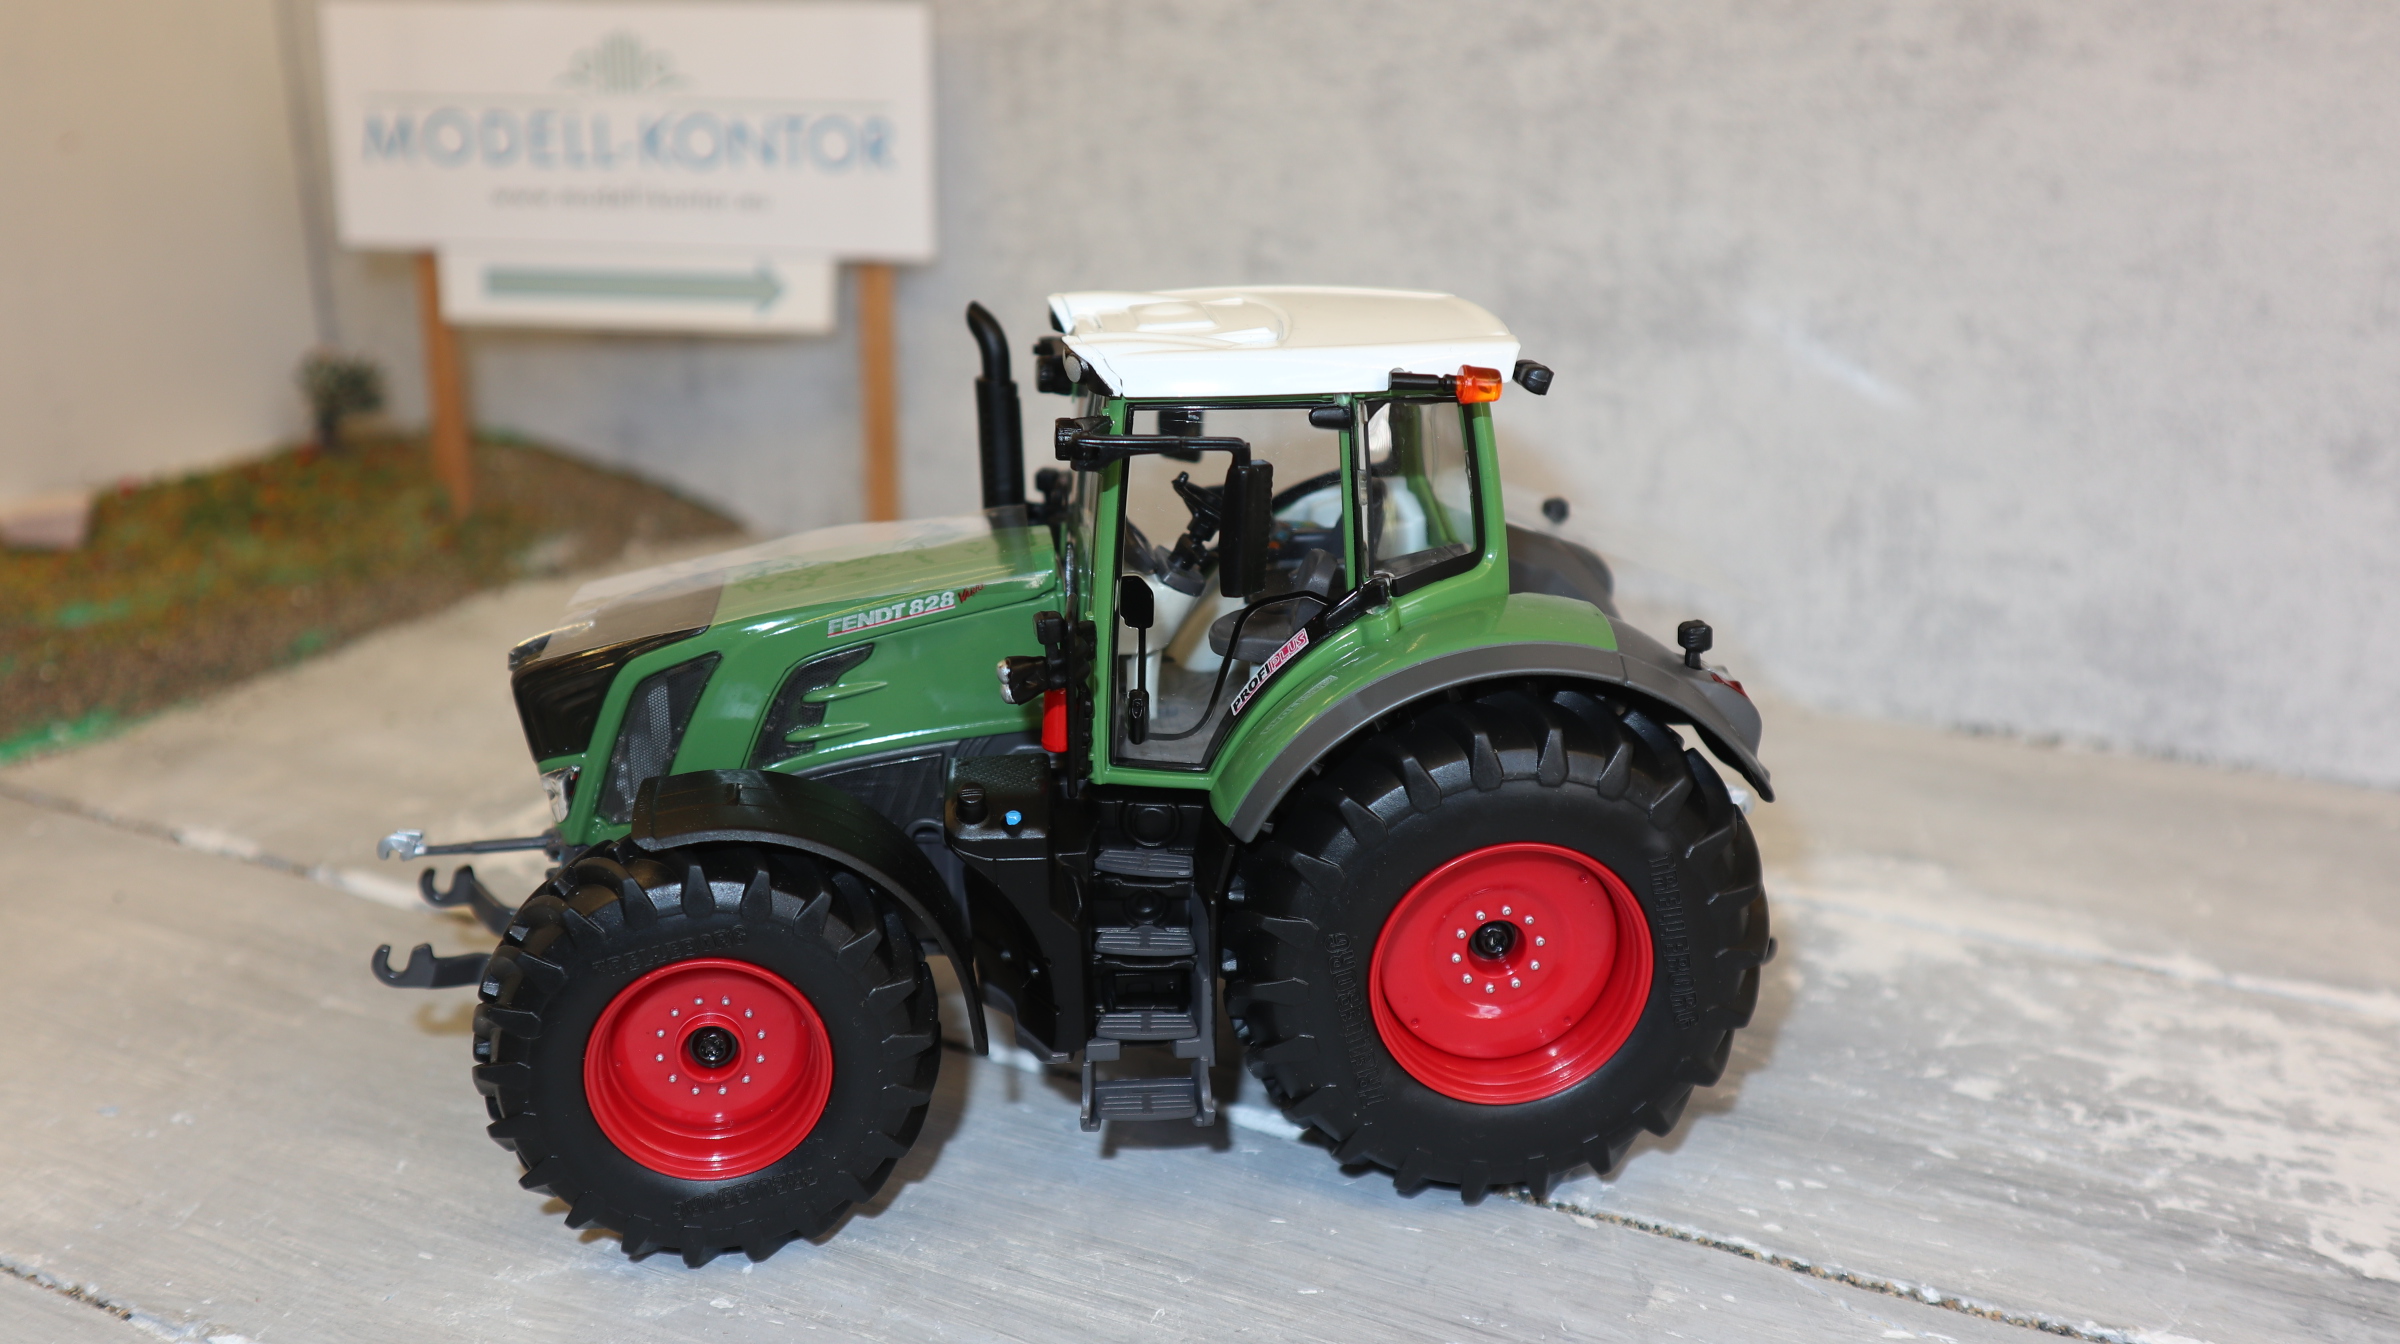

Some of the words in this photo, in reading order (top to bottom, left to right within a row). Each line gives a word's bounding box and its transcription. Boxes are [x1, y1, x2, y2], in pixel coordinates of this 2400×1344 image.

[362, 107, 900, 176] MODELL-KONTOR
[827, 602, 907, 636] FENDT
[909, 591, 955, 617] 828
[1648, 852, 1701, 1031] TRELLEBORG
[1323, 932, 1385, 1109] TRELLEBORG
